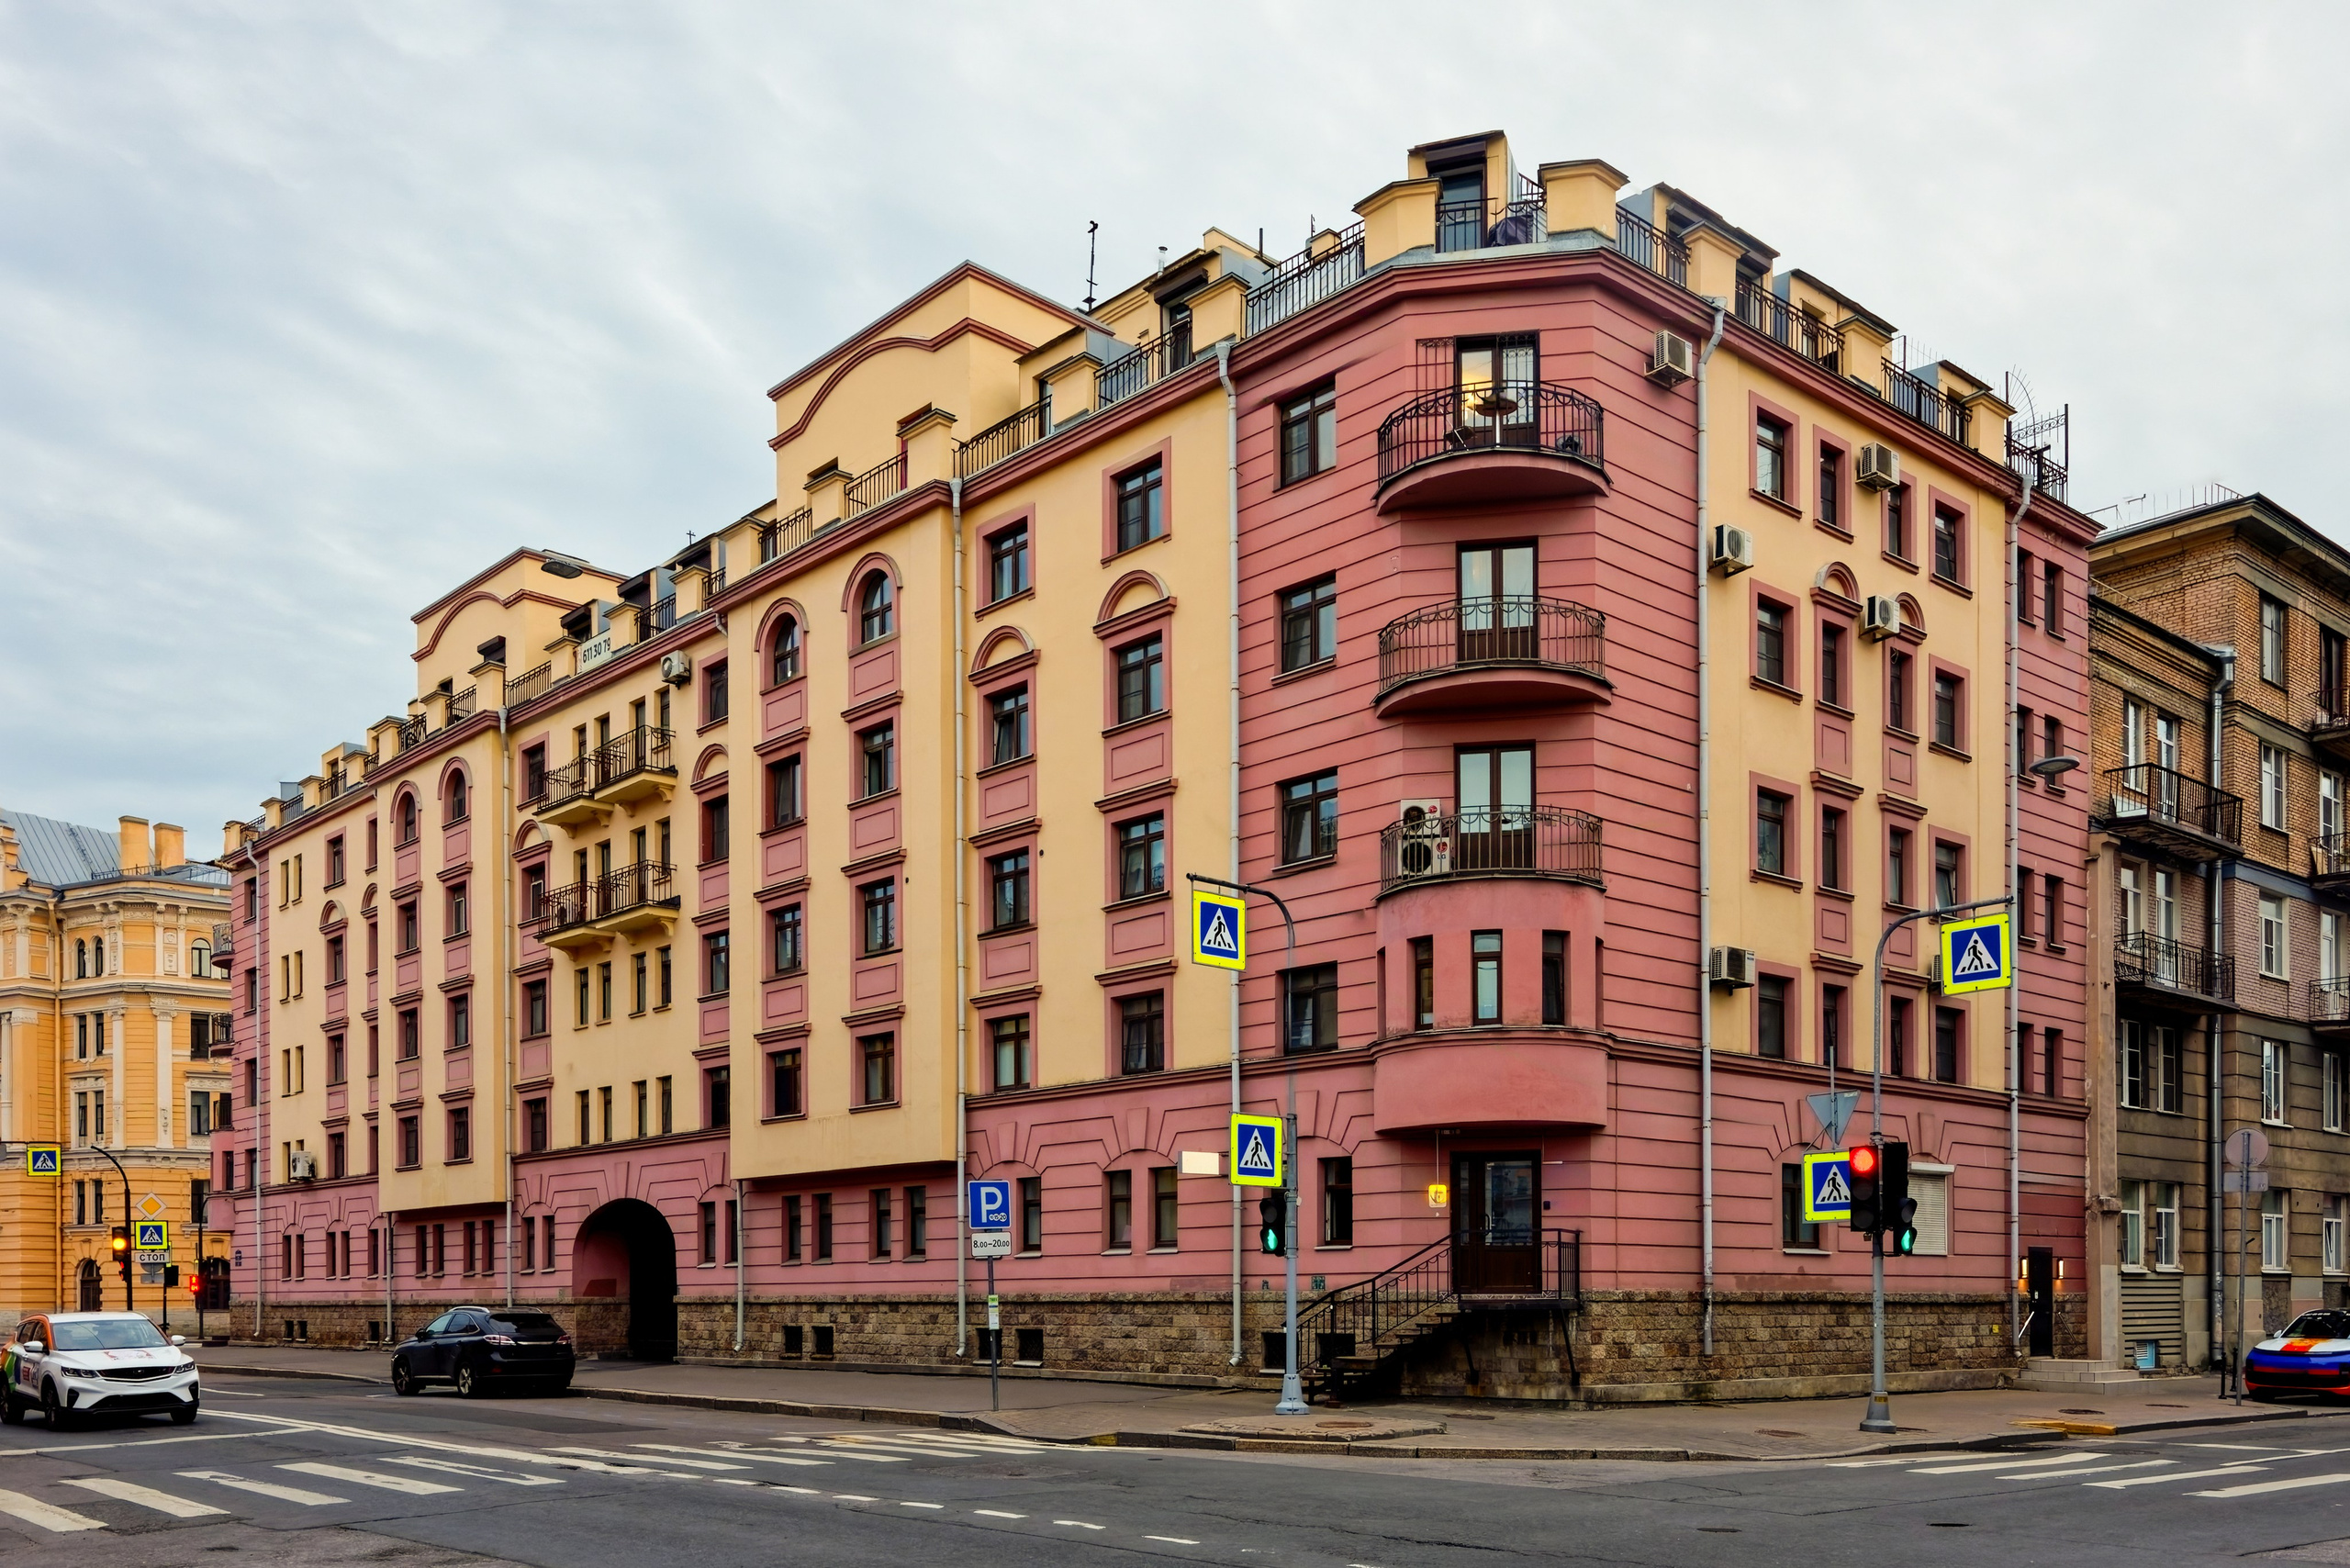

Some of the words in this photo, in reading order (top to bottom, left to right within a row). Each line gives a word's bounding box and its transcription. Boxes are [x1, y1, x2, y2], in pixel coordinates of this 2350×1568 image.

[582, 646, 593, 663] 611
[593, 642, 602, 658] 30
[602, 637, 611, 653] 79
[980, 1186, 1002, 1223] P
[139, 1253, 165, 1261] СТОП
